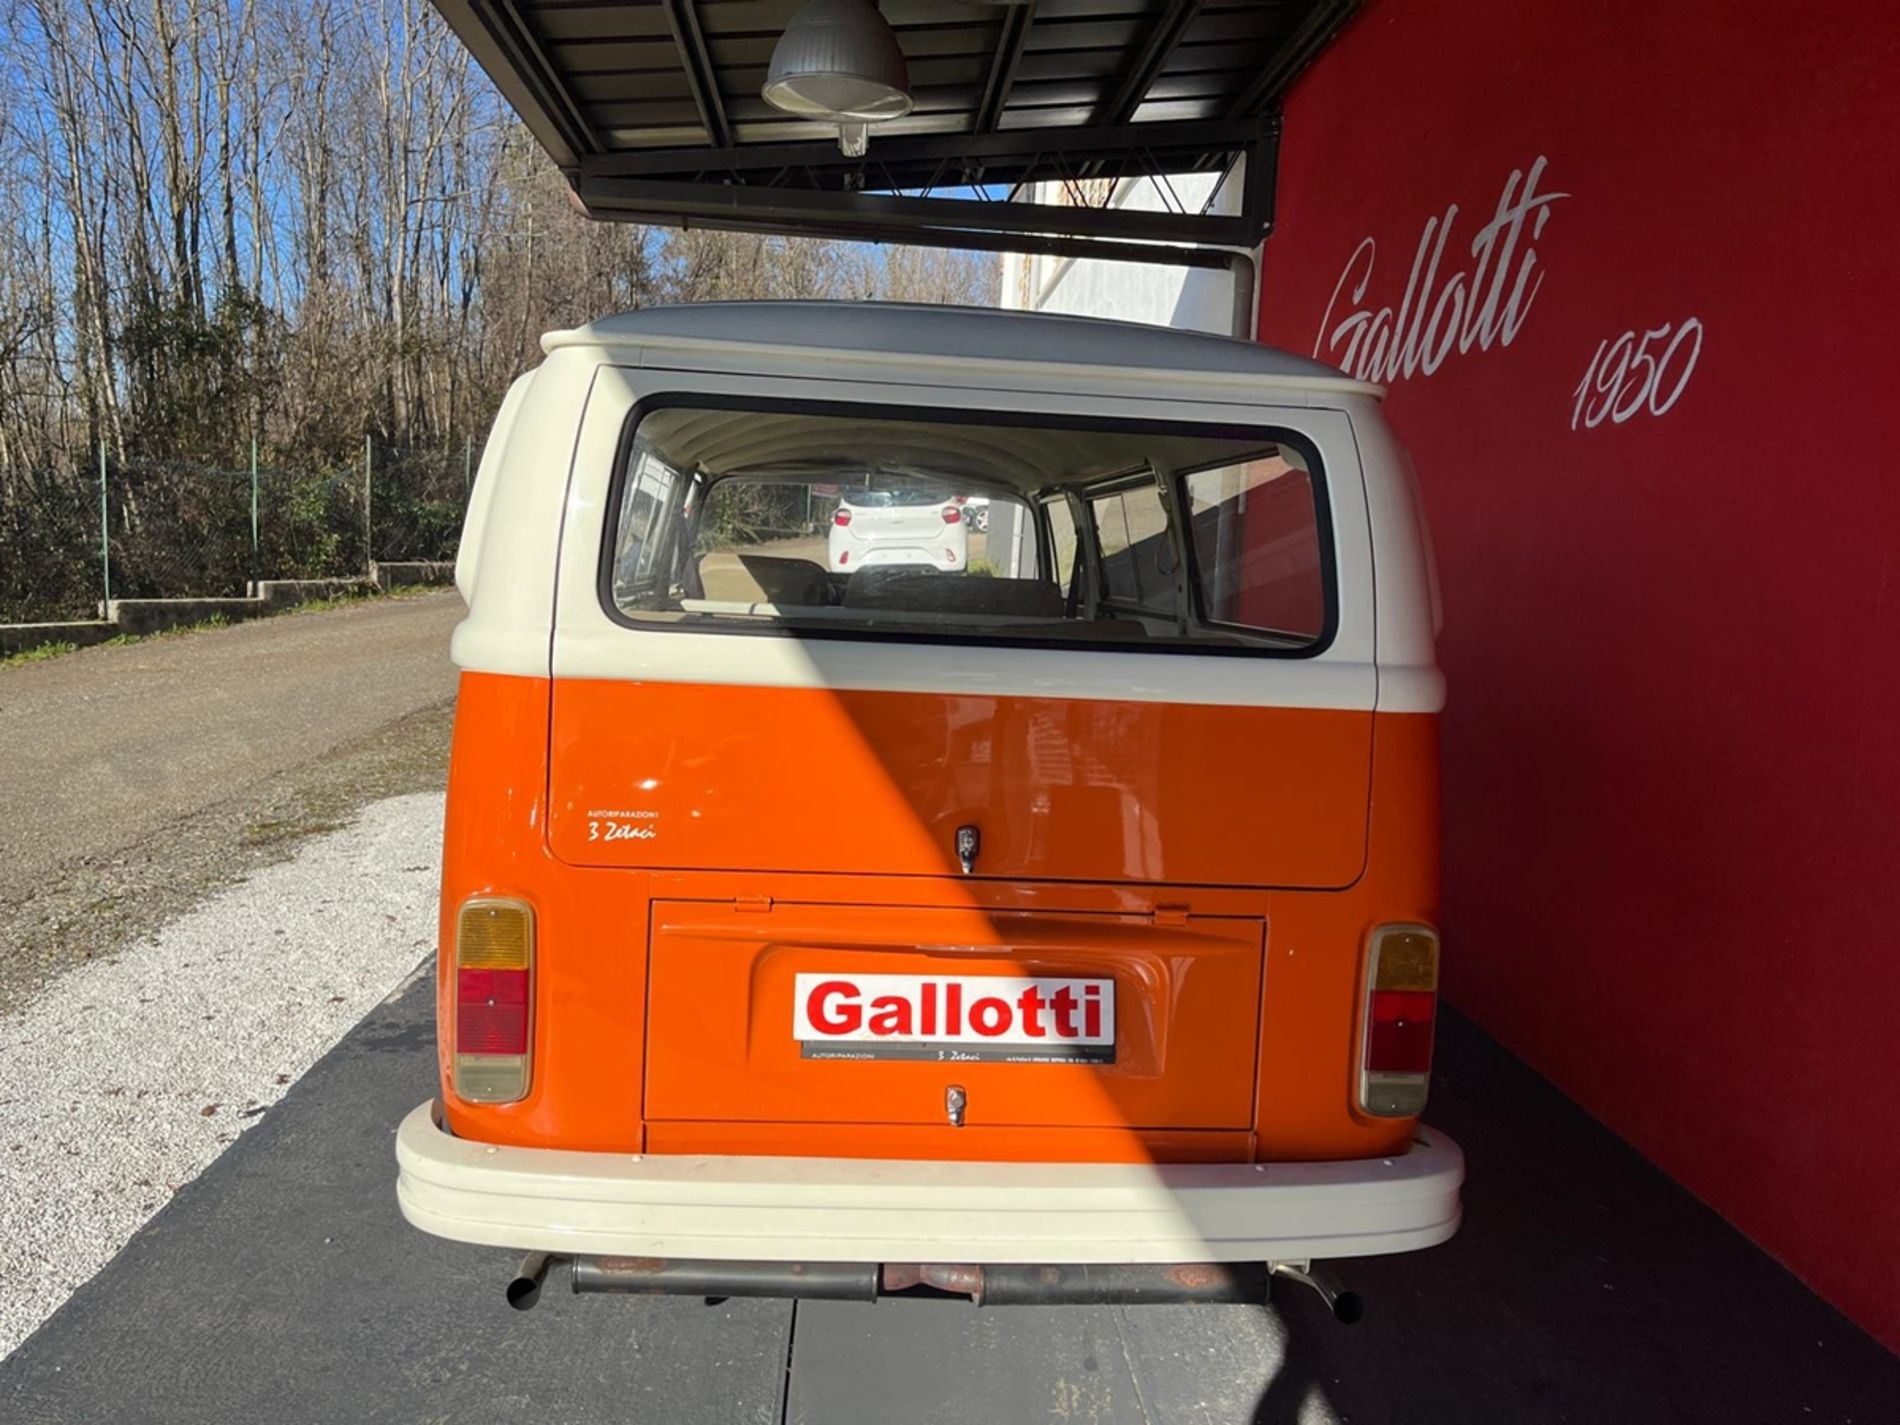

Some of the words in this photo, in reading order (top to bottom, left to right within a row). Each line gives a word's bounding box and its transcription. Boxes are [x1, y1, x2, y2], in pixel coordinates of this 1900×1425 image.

[1312, 154, 1571, 383] Gallotti
[1570, 316, 1703, 431] 1950
[587, 809, 659, 819] AUTORIPARAZIONI
[588, 821, 599, 841] 3
[806, 980, 1101, 1039] Gallotti
